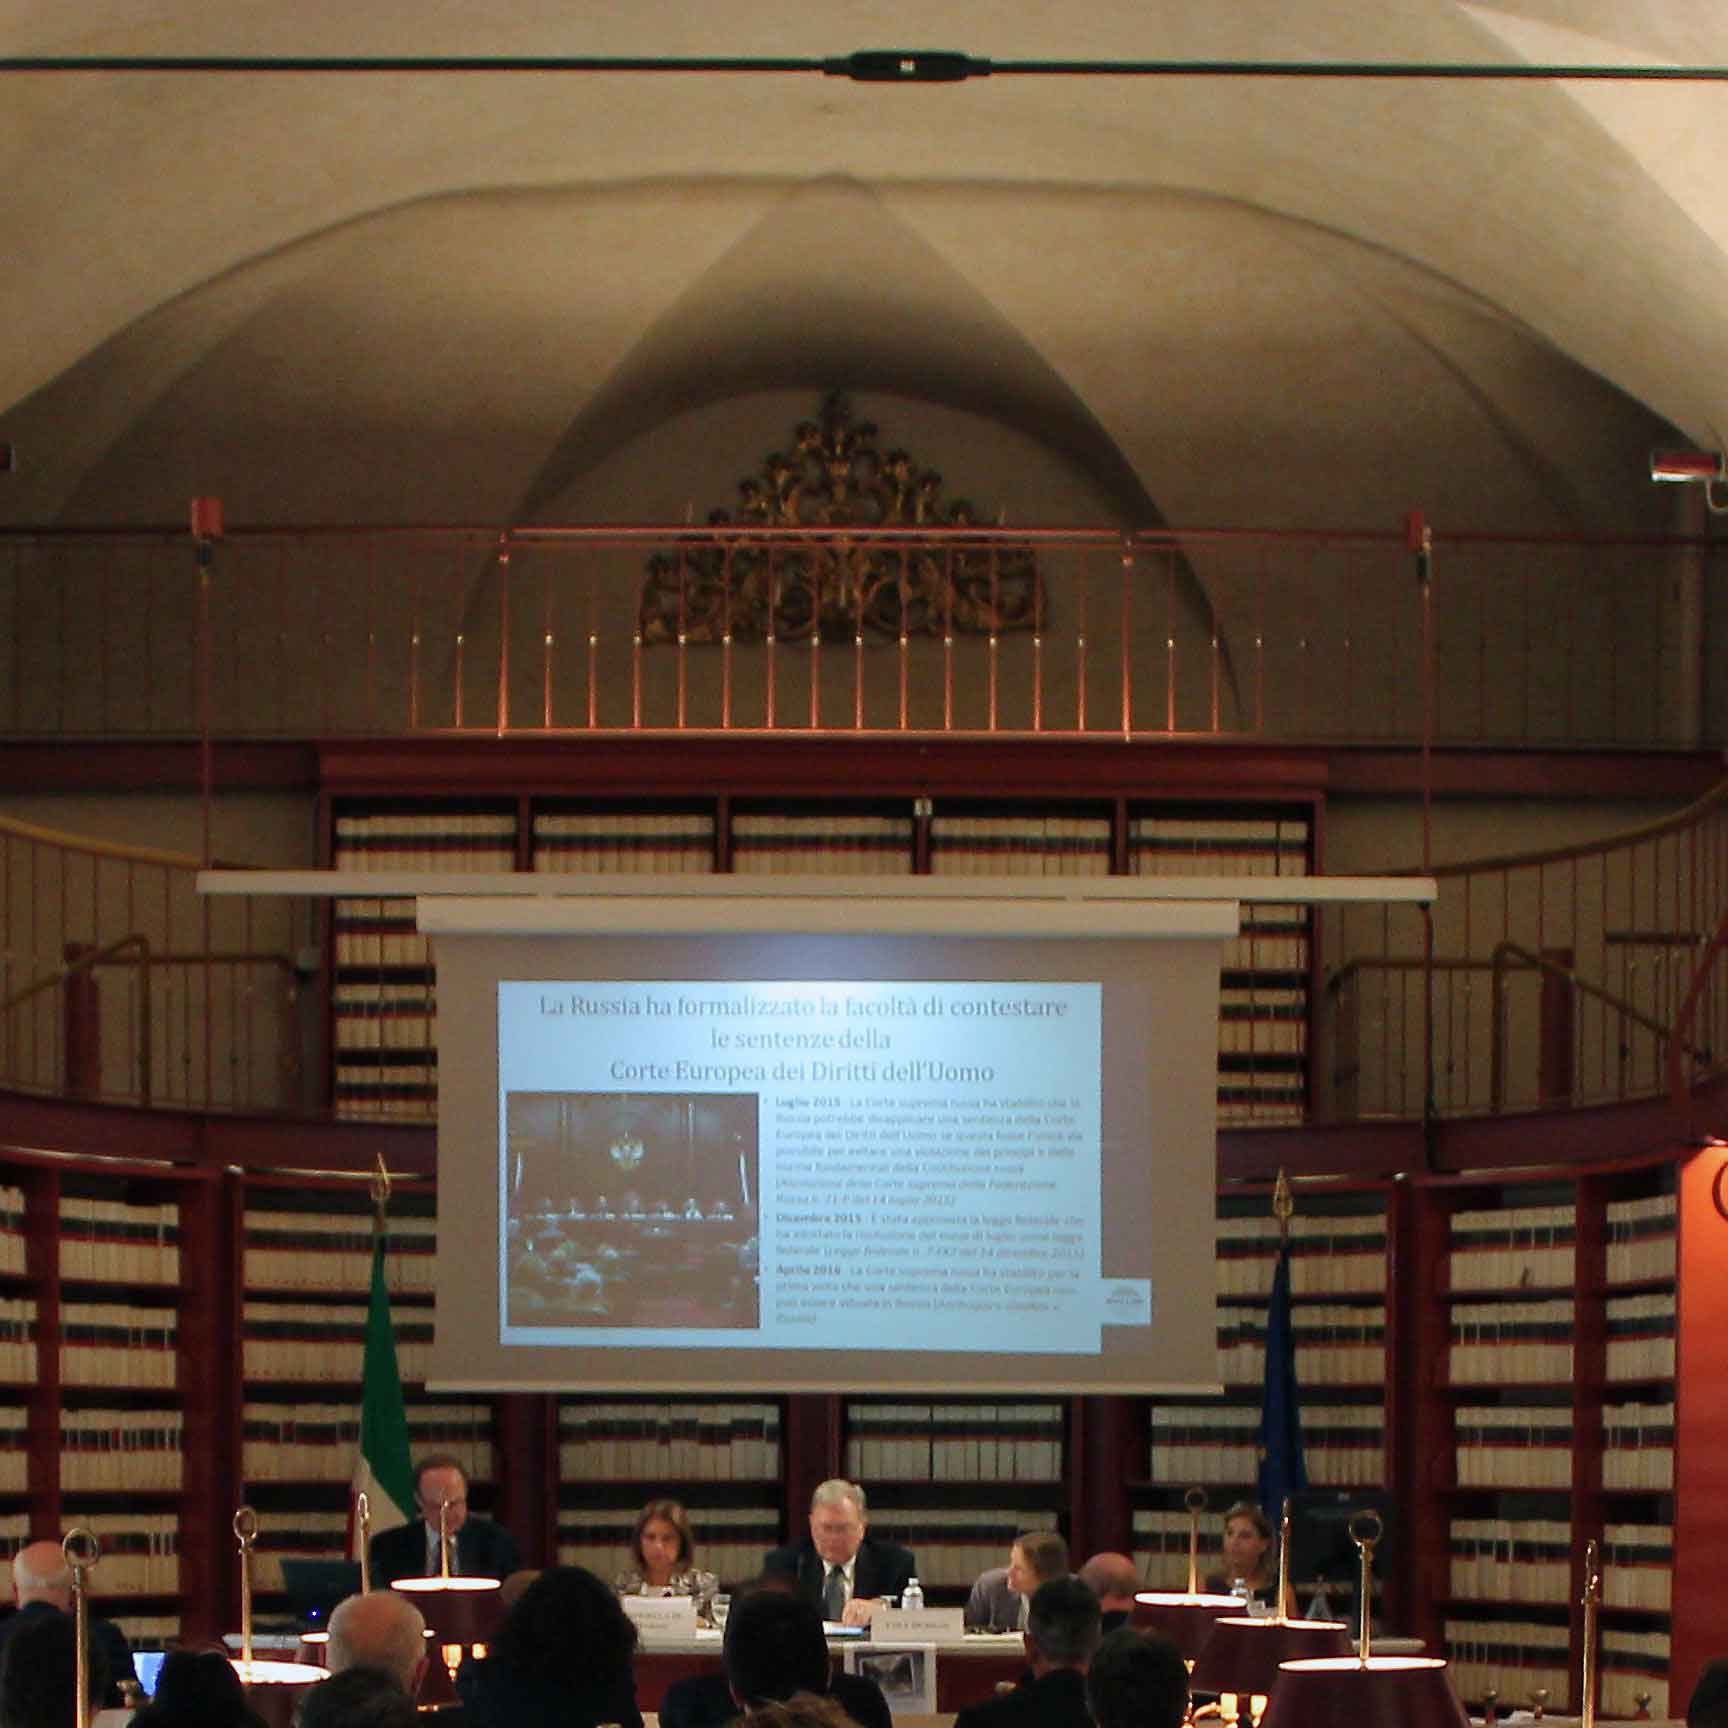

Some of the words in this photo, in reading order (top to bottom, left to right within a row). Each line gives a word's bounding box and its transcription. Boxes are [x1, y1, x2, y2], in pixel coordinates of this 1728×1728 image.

[536, 994, 565, 1017] La
[569, 994, 641, 1017] Russia
[645, 994, 673, 1017] ha
[677, 994, 816, 1017] formalizzato
[819, 995, 839, 1017] la
[844, 995, 918, 1017] facoltà
[922, 995, 944, 1017] di
[949, 996, 1069, 1017] contestare
[710, 1026, 731, 1049] le
[733, 1031, 835, 1049] sentenze
[836, 1027, 892, 1049] della
[609, 1060, 672, 1081] Corte
[674, 1060, 767, 1087] Europea
[771, 1060, 806, 1081] dei
[811, 1060, 877, 1081] Diritti
[881, 1060, 996, 1082] dell'Uomo
